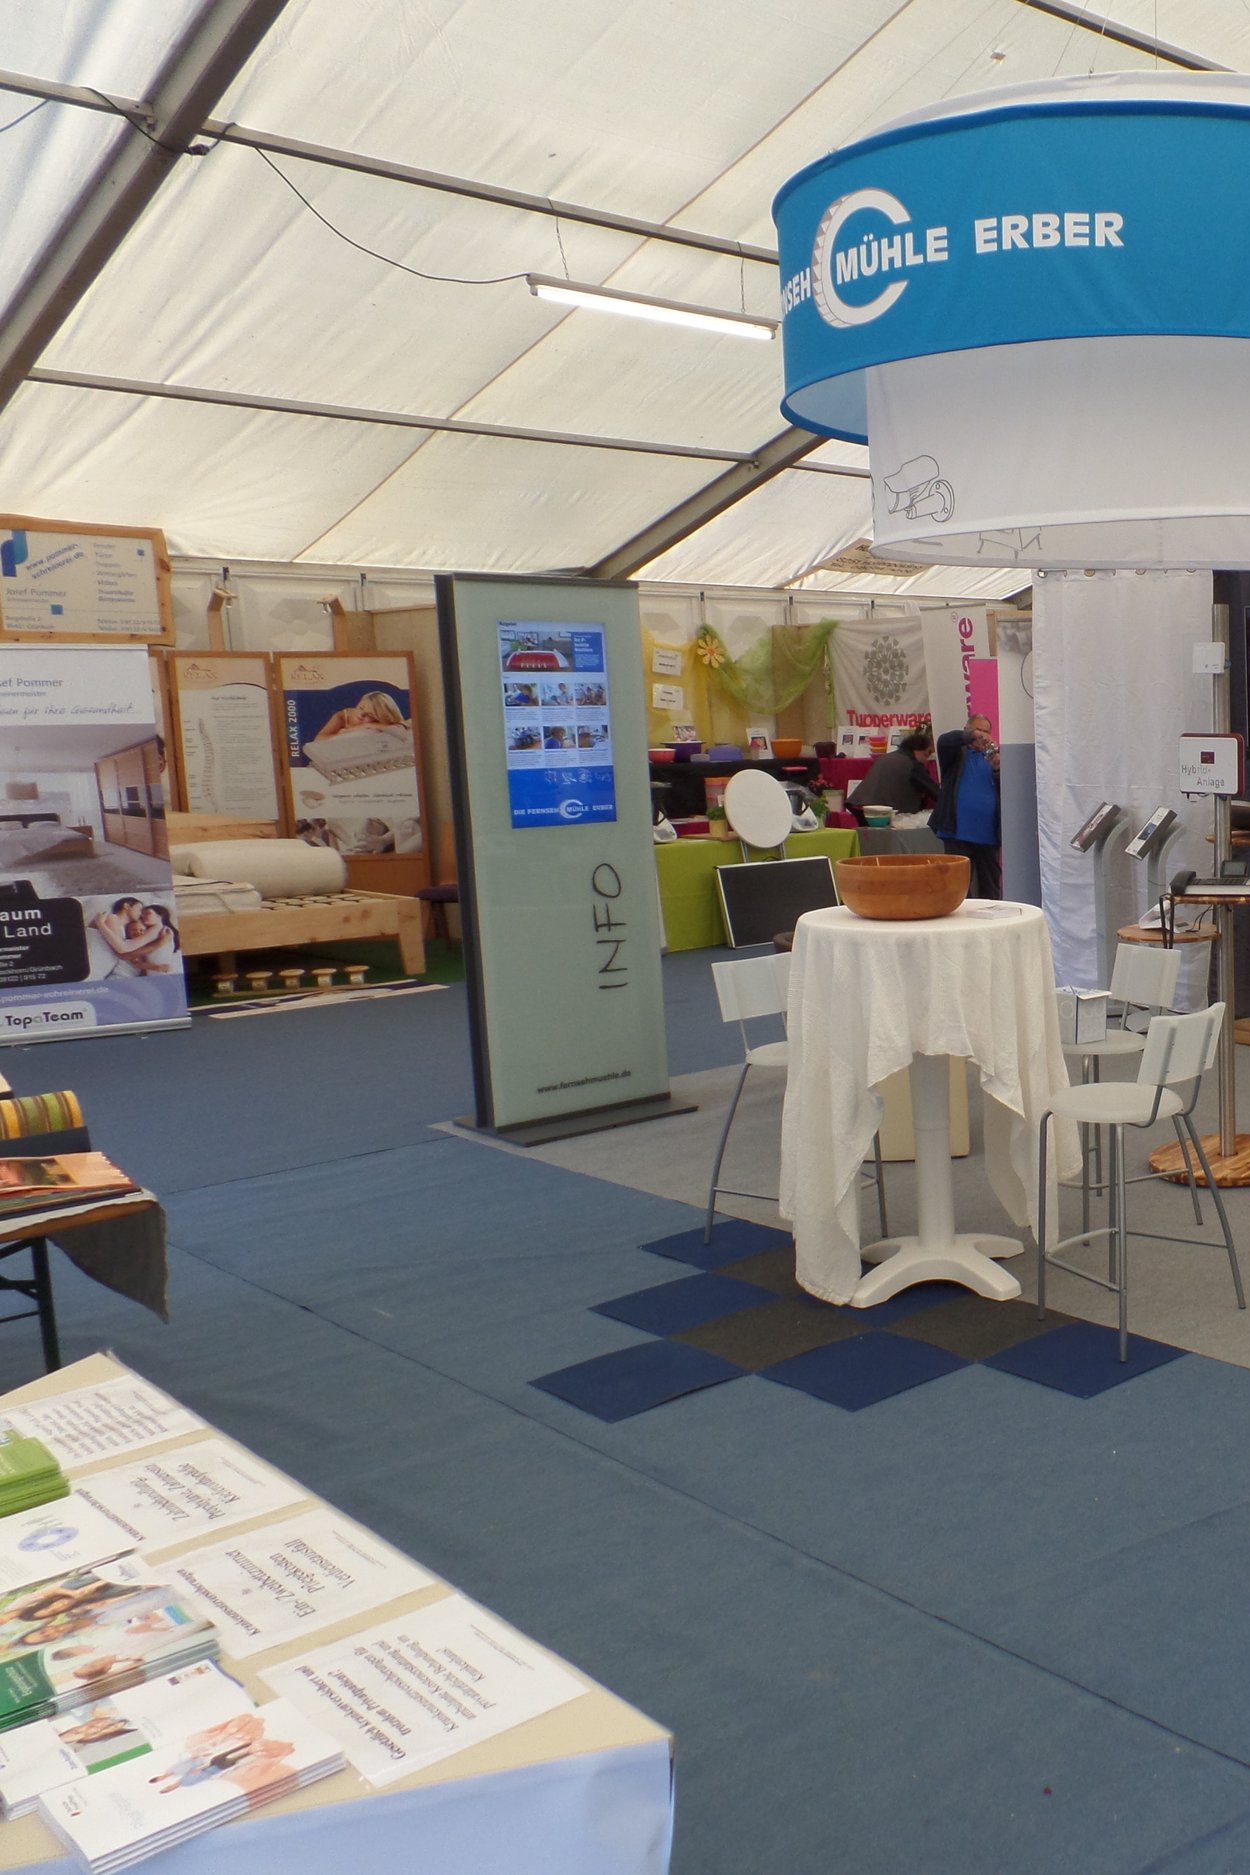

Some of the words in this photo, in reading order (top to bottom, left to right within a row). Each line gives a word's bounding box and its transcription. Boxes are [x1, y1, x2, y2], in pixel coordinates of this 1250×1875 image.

[836, 226, 948, 285] MÜHLE
[974, 212, 1124, 254] ERBER
[17, 678, 63, 688] Pommer
[287, 699, 298, 723] 2000
[847, 710, 932, 728] Tupperware
[291, 724, 300, 758] RELAX
[1196, 777, 1225, 788] Anlage
[4, 923, 52, 938] Land
[592, 863, 628, 989] INFO
[537, 1069, 631, 1094] www.fernsehmuehle.de
[283, 1536, 355, 1589] Verdienstausfall
[294, 1664, 314, 1677] und
[306, 1674, 370, 1729] krankenversichert
[374, 1707, 411, 1736] trotzdem
[363, 1724, 406, 1760] Gesetzlich
